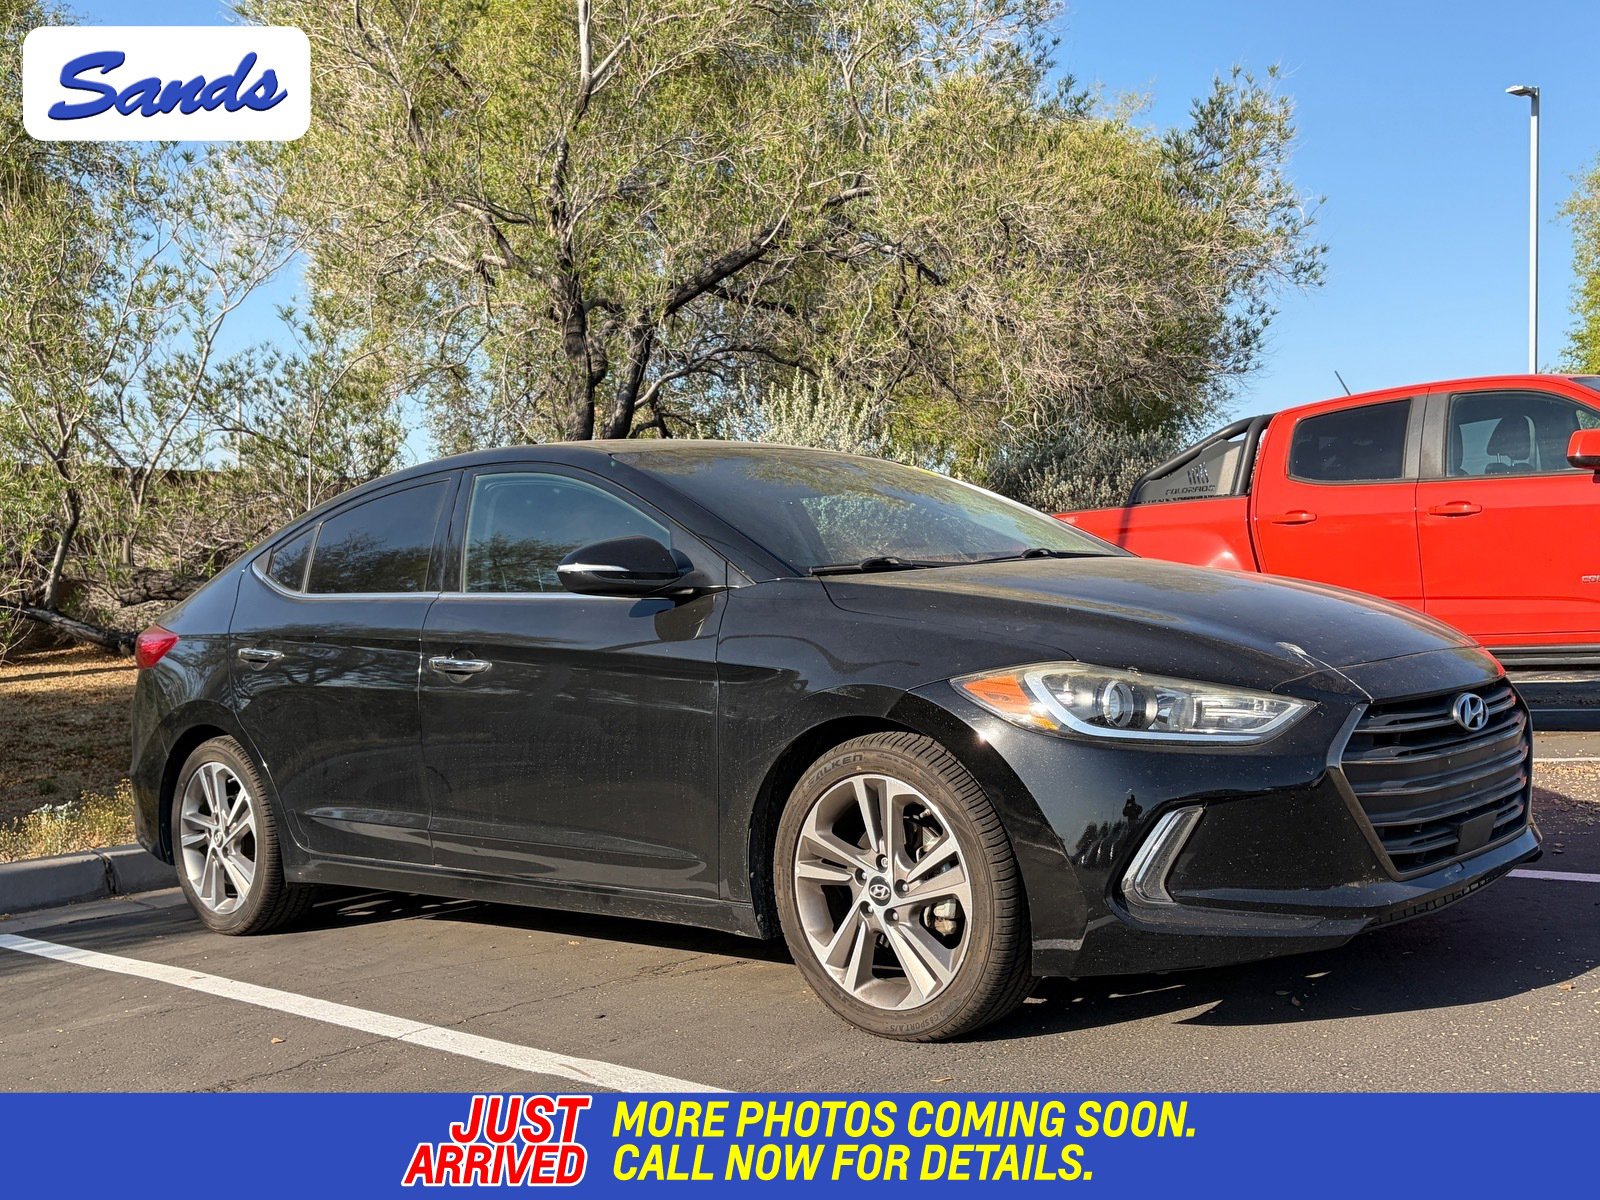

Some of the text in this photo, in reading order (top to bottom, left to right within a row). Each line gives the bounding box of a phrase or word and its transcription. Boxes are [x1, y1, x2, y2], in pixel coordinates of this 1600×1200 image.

[1165, 484, 1216, 496] COLORADO
[807, 753, 863, 787] FALKEN
[905, 1018, 929, 1031] SPORT
